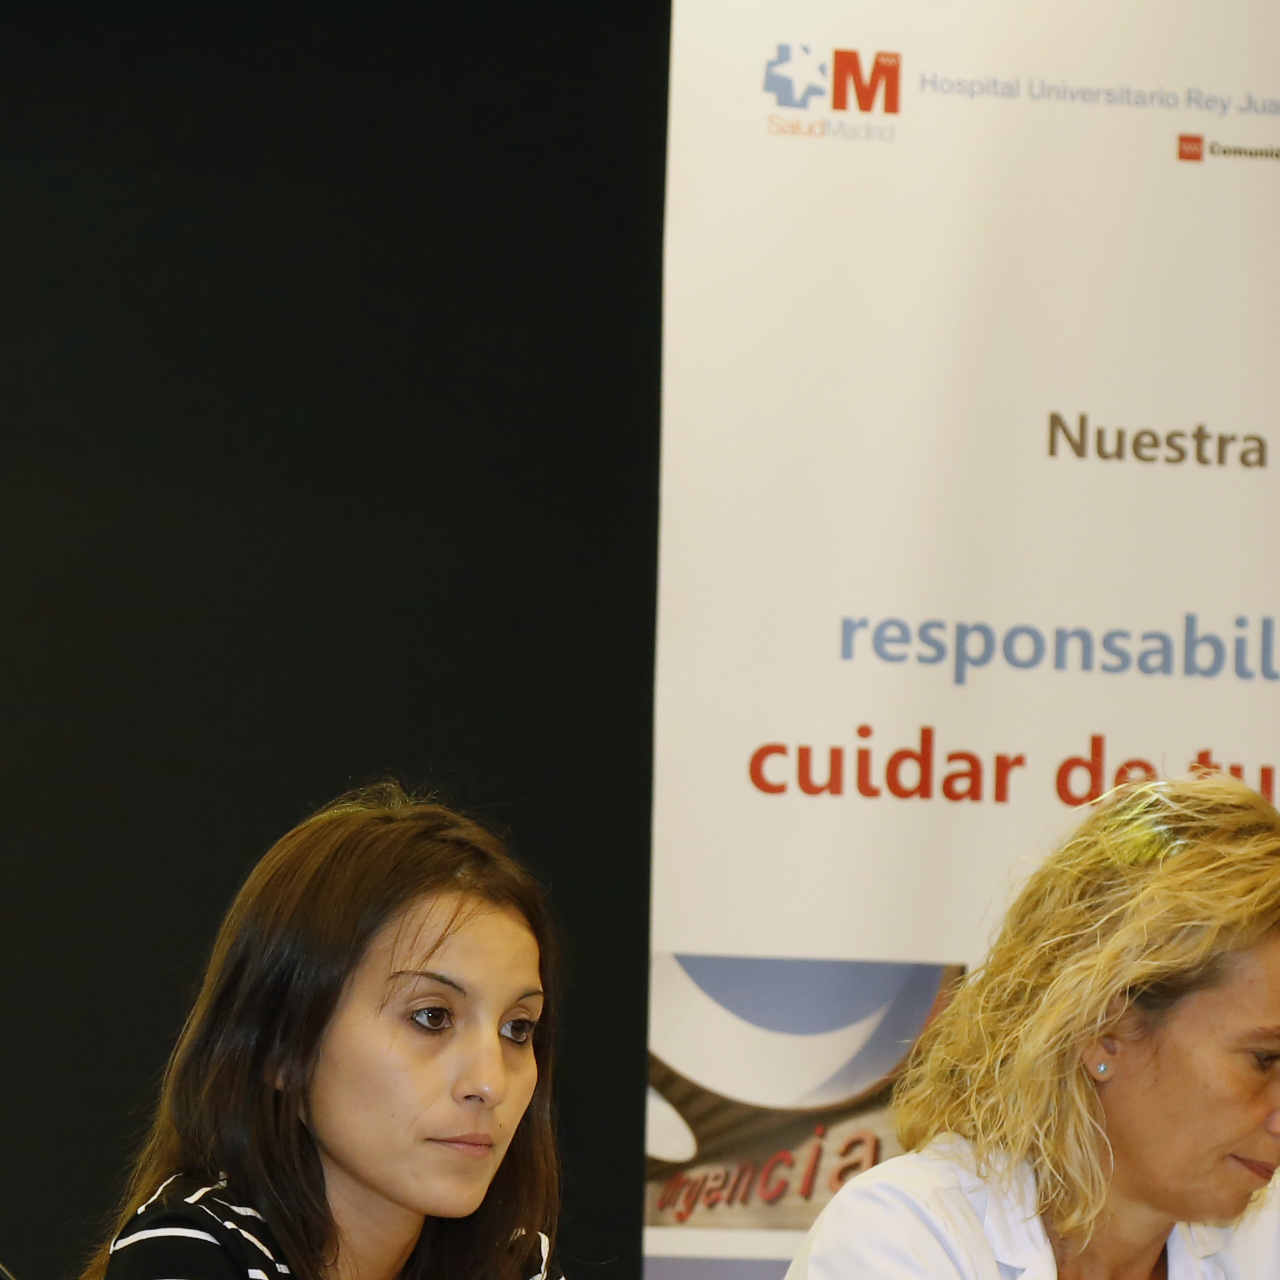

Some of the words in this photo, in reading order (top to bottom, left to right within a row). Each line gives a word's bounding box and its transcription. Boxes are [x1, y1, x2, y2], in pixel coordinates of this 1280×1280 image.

[920, 71, 1020, 101] Hospital
[1027, 78, 1180, 110] Universitario
[1186, 88, 1231, 115] Rey
[1047, 412, 1268, 468] Nuestra
[747, 724, 1026, 803] cuidar
